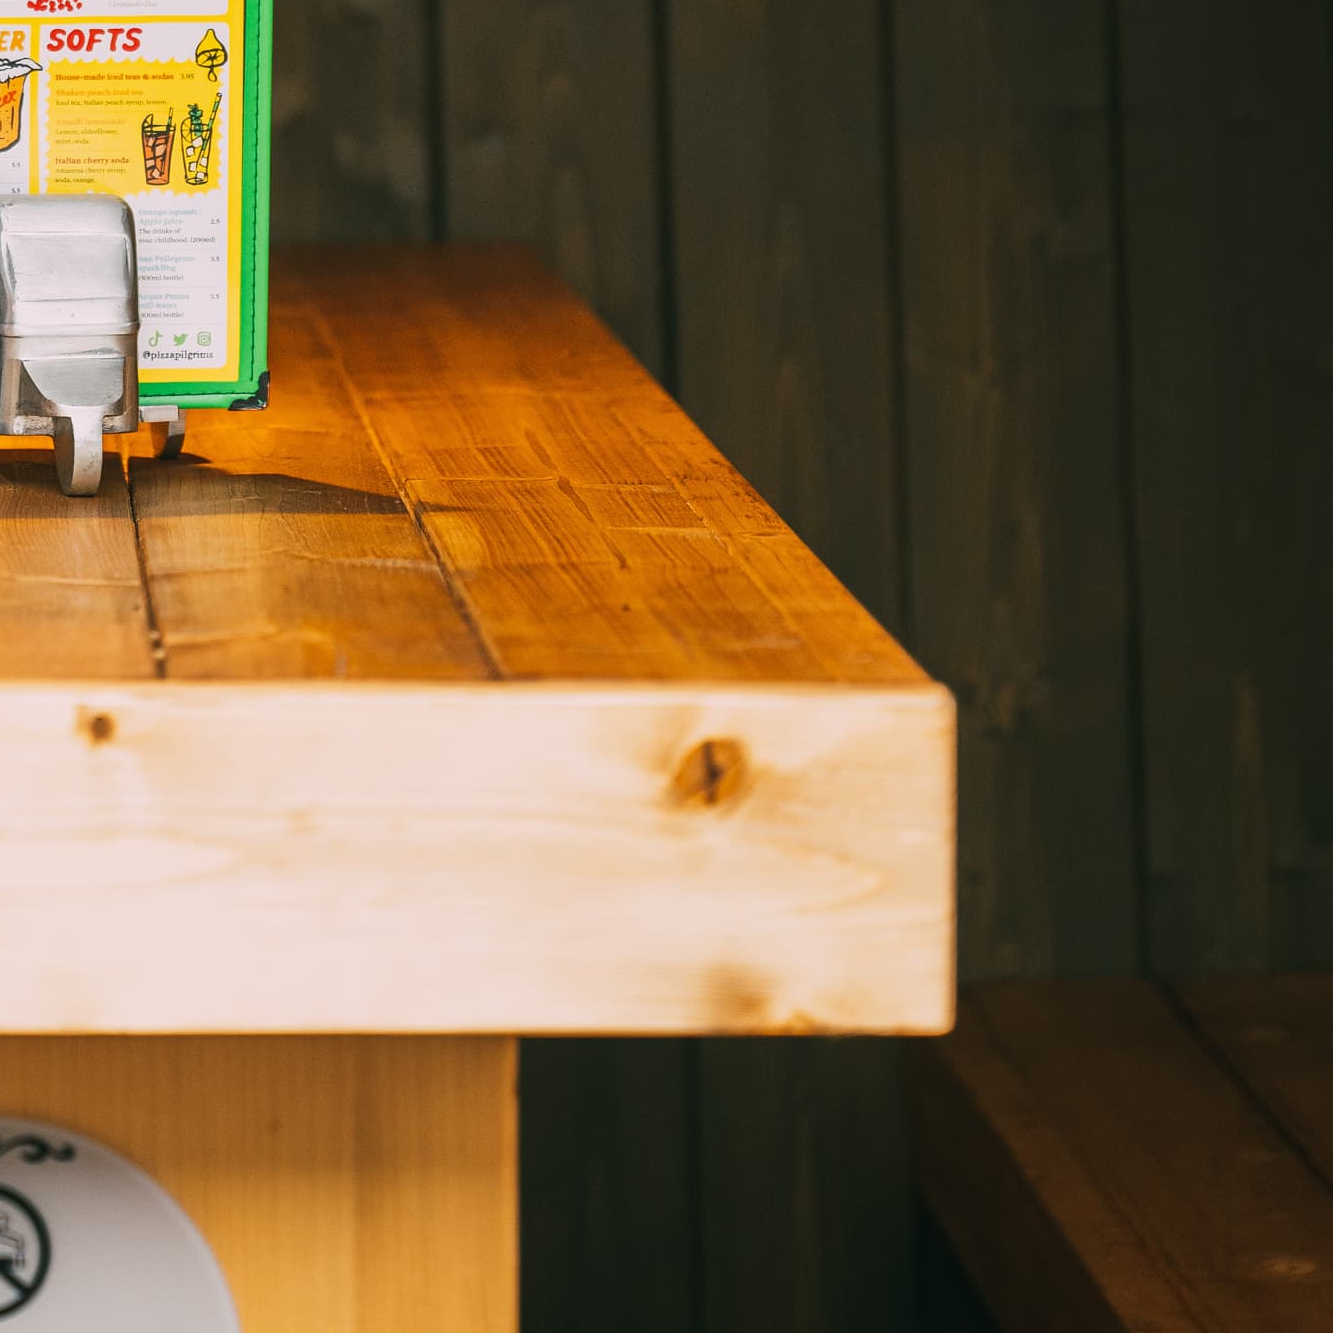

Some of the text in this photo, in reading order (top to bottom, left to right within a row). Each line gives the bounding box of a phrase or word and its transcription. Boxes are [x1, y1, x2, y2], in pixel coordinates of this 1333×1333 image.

[46, 27, 143, 53] SOFTS
[55, 73, 106, 81] House-made
[107, 72, 124, 81] iced
[125, 73, 141, 81] teas
[151, 72, 174, 80] sodas
[83, 157, 109, 166] cherry
[143, 350, 214, 361] @pizzapilgrims
